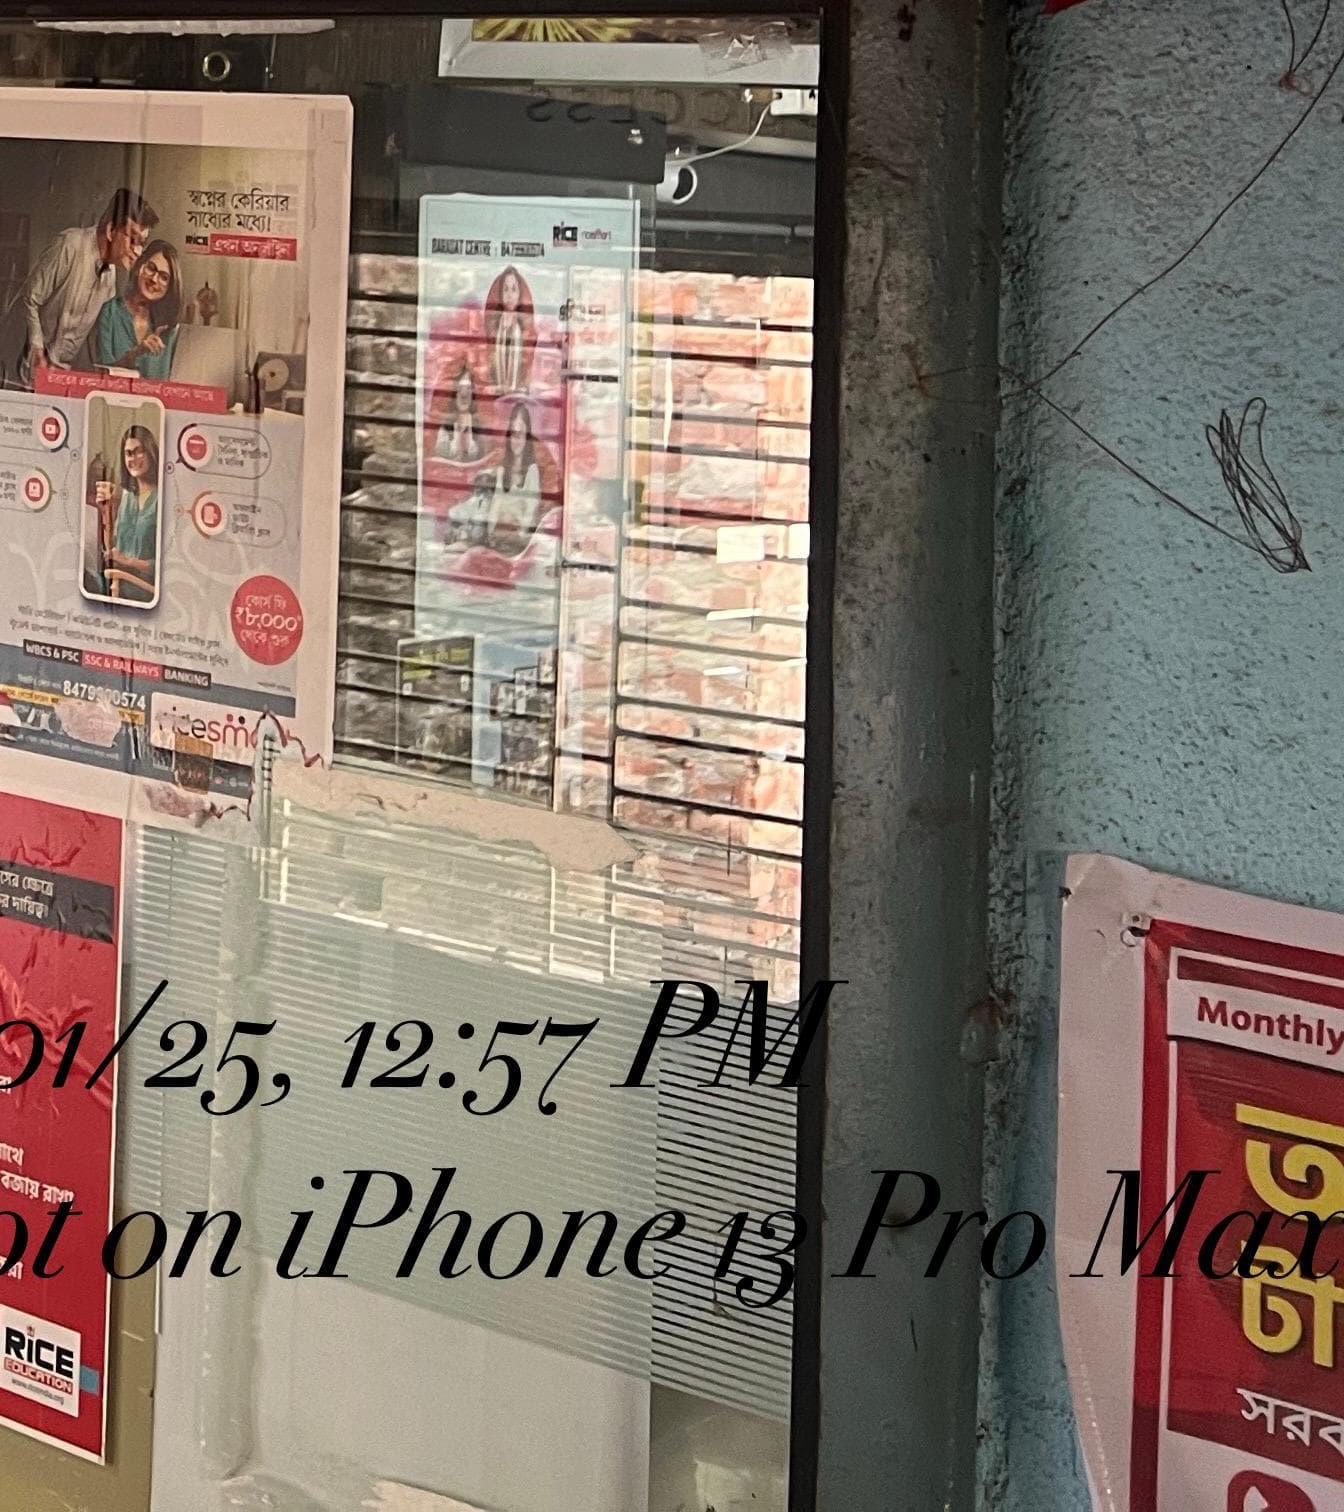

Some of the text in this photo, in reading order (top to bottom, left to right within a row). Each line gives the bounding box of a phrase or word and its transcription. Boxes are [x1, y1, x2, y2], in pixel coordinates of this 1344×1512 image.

[25, 643, 51, 658] WBCS
[62, 650, 80, 663] PSC
[84, 653, 102, 667] SSC
[164, 670, 209, 686] BANKING
[1197, 996, 1344, 1055] Monthly
[4, 1358, 73, 1394] EDUCATION
